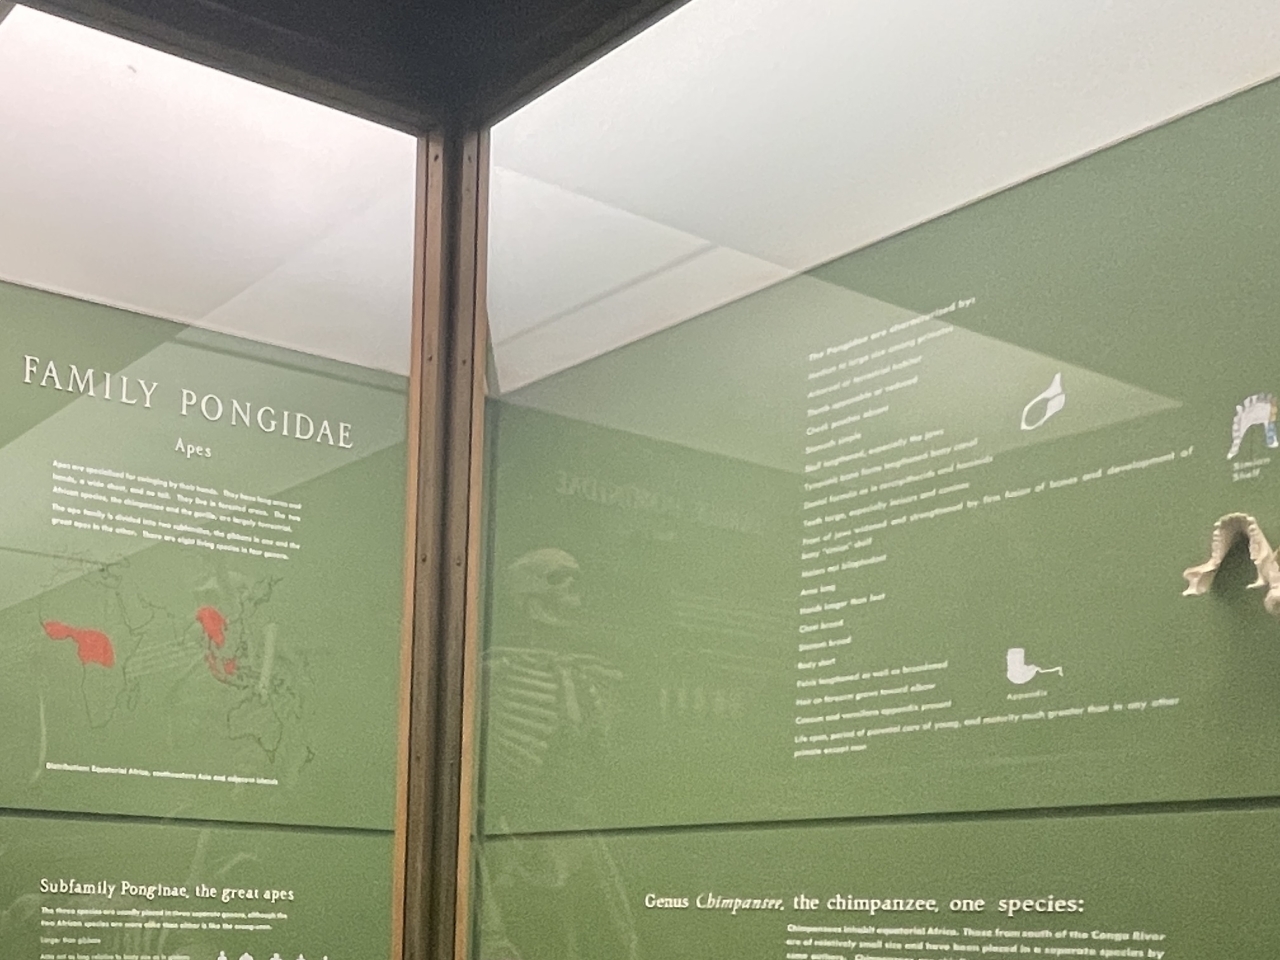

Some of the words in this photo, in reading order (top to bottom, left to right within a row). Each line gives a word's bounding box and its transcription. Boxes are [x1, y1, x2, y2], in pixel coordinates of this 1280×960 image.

[24, 355, 158, 407] FAMILY
[182, 389, 353, 448] PONGIDAE
[175, 438, 211, 458] Apes
[40, 878, 115, 898] Subfamily
[196, 884, 217, 897] the
[222, 888, 258, 902] great
[264, 890, 294, 903] apes
[645, 894, 689, 907] Genus
[794, 894, 819, 909] the
[827, 894, 938, 915] chimpanzee,
[950, 899, 985, 911] one
[998, 895, 1084, 916] species:
